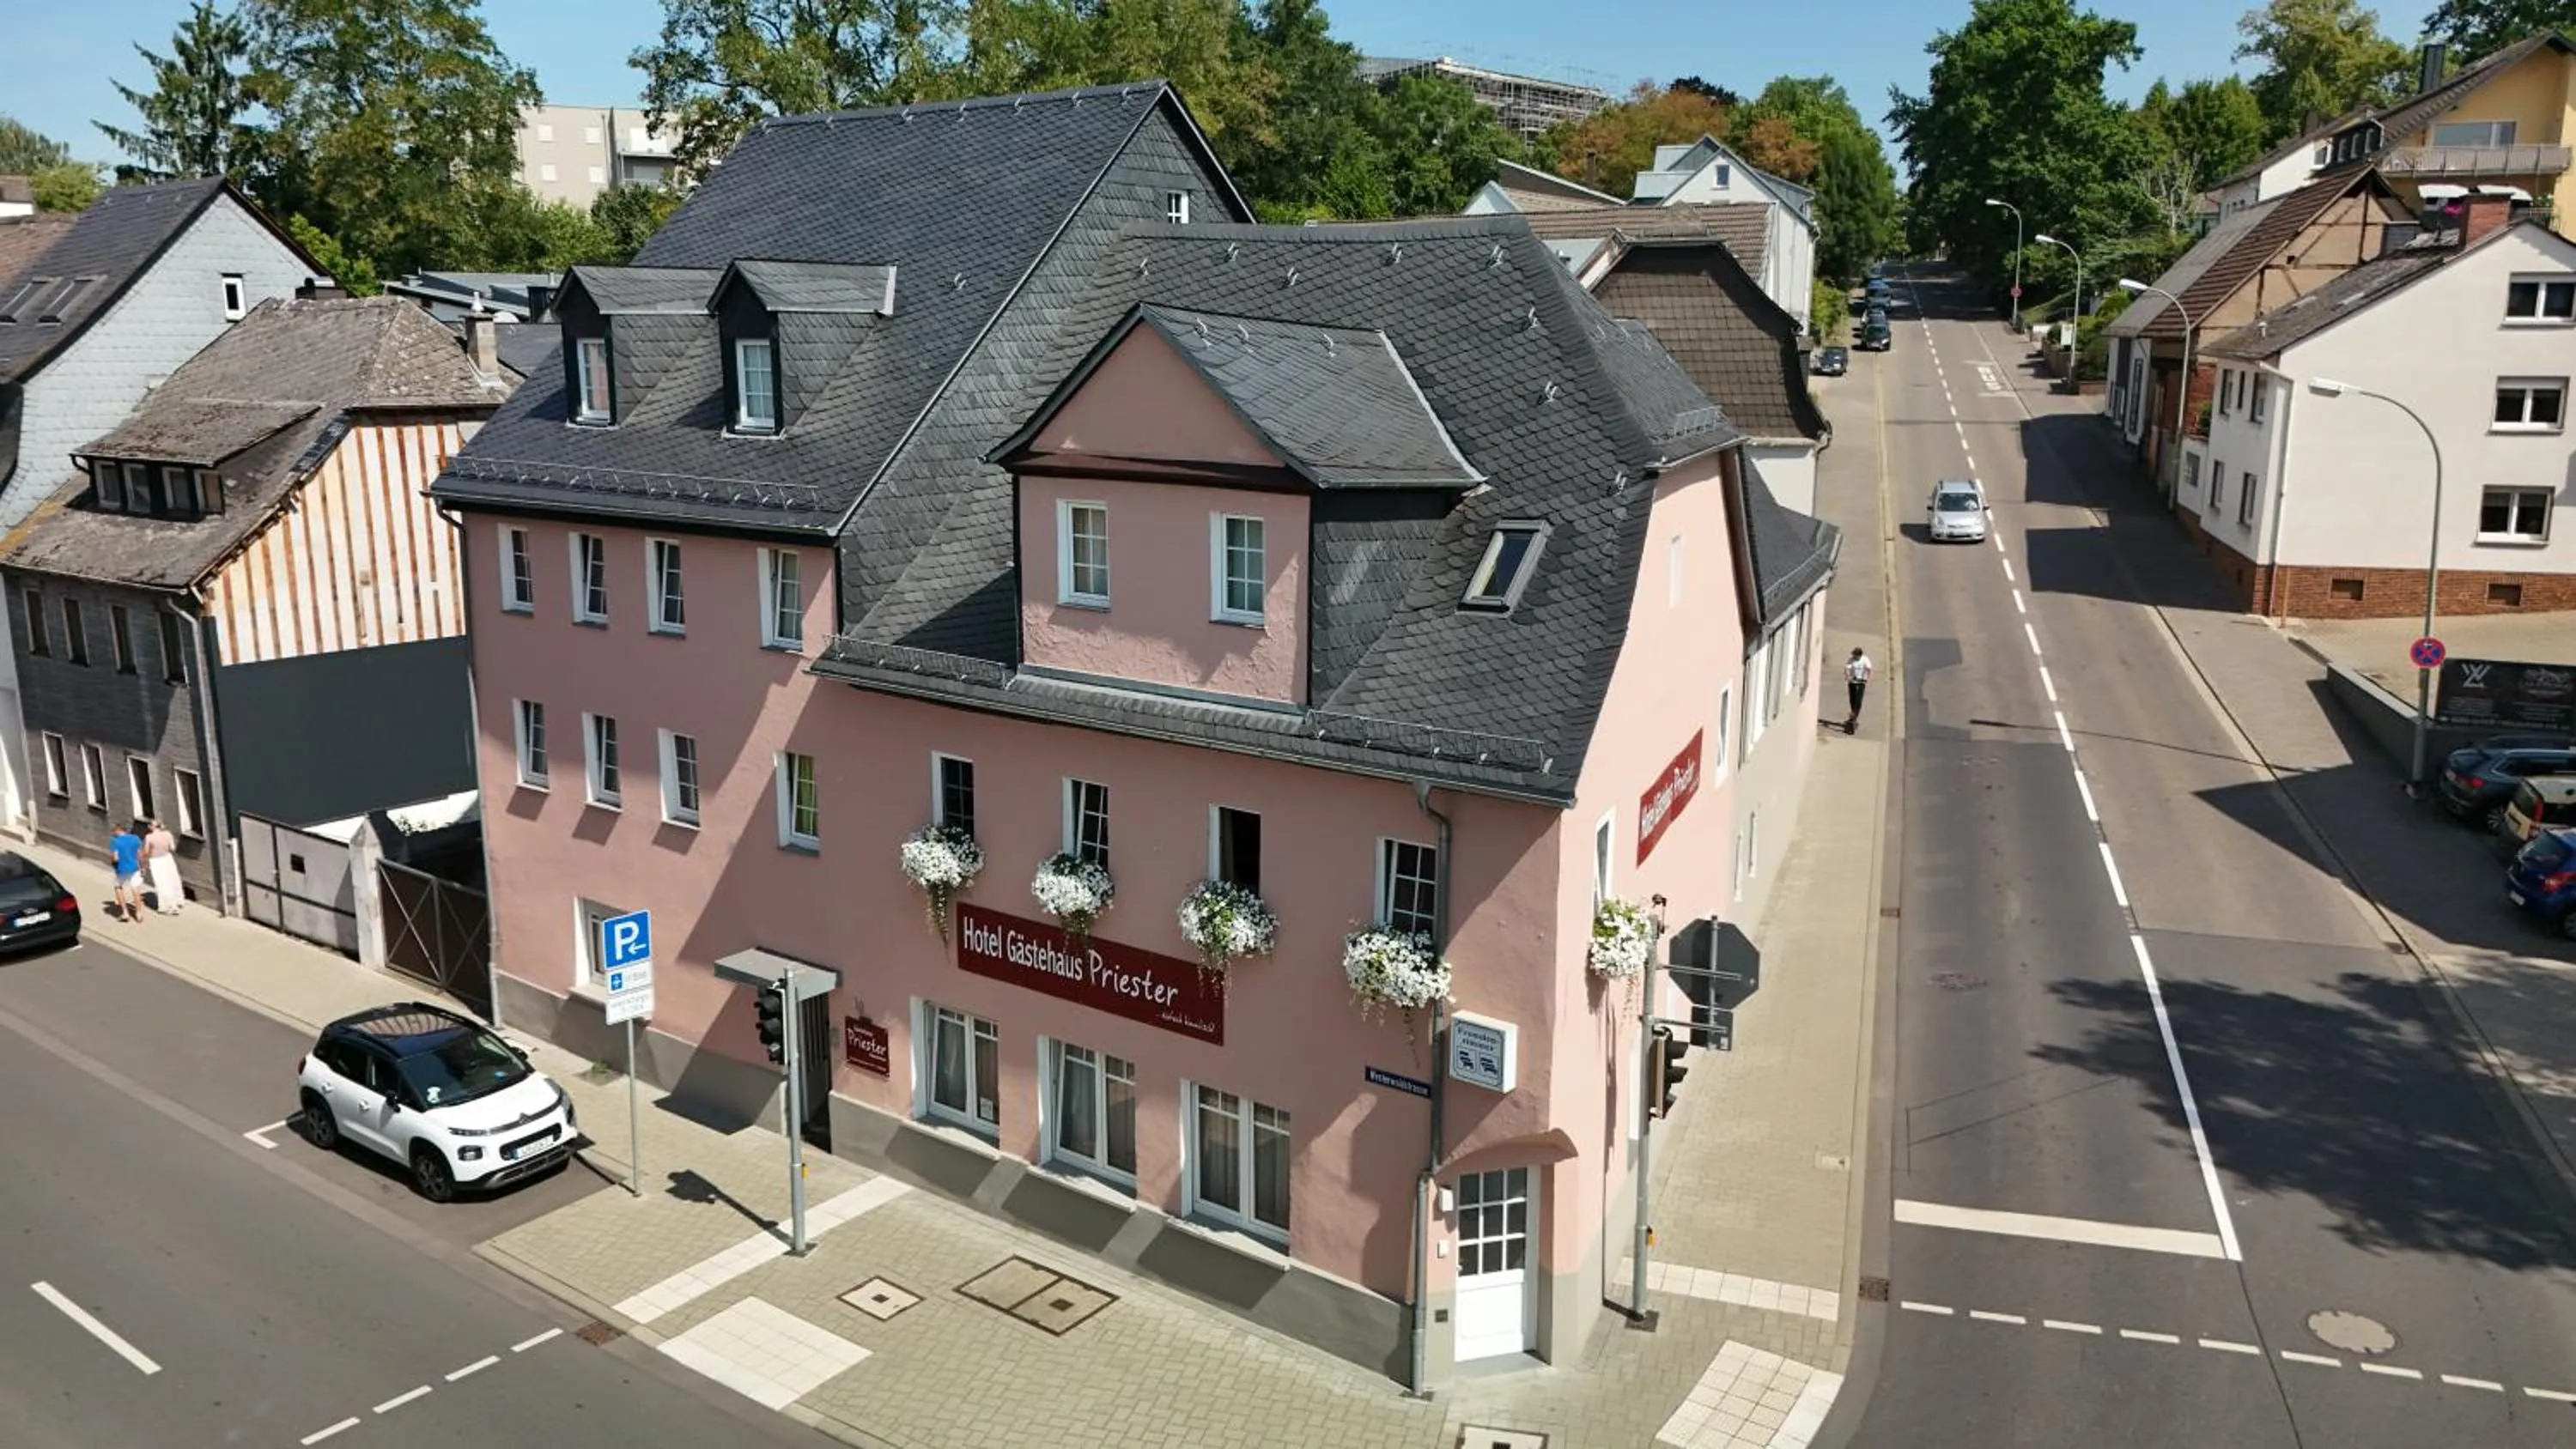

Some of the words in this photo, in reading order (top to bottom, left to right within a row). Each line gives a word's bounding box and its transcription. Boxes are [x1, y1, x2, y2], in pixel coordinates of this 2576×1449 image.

[614, 921, 640, 961] P
[963, 916, 1003, 960] Hotel
[1006, 930, 1084, 982] Gästehaus
[1088, 949, 1179, 1006] Priester
[848, 1028, 887, 1055] Priester
